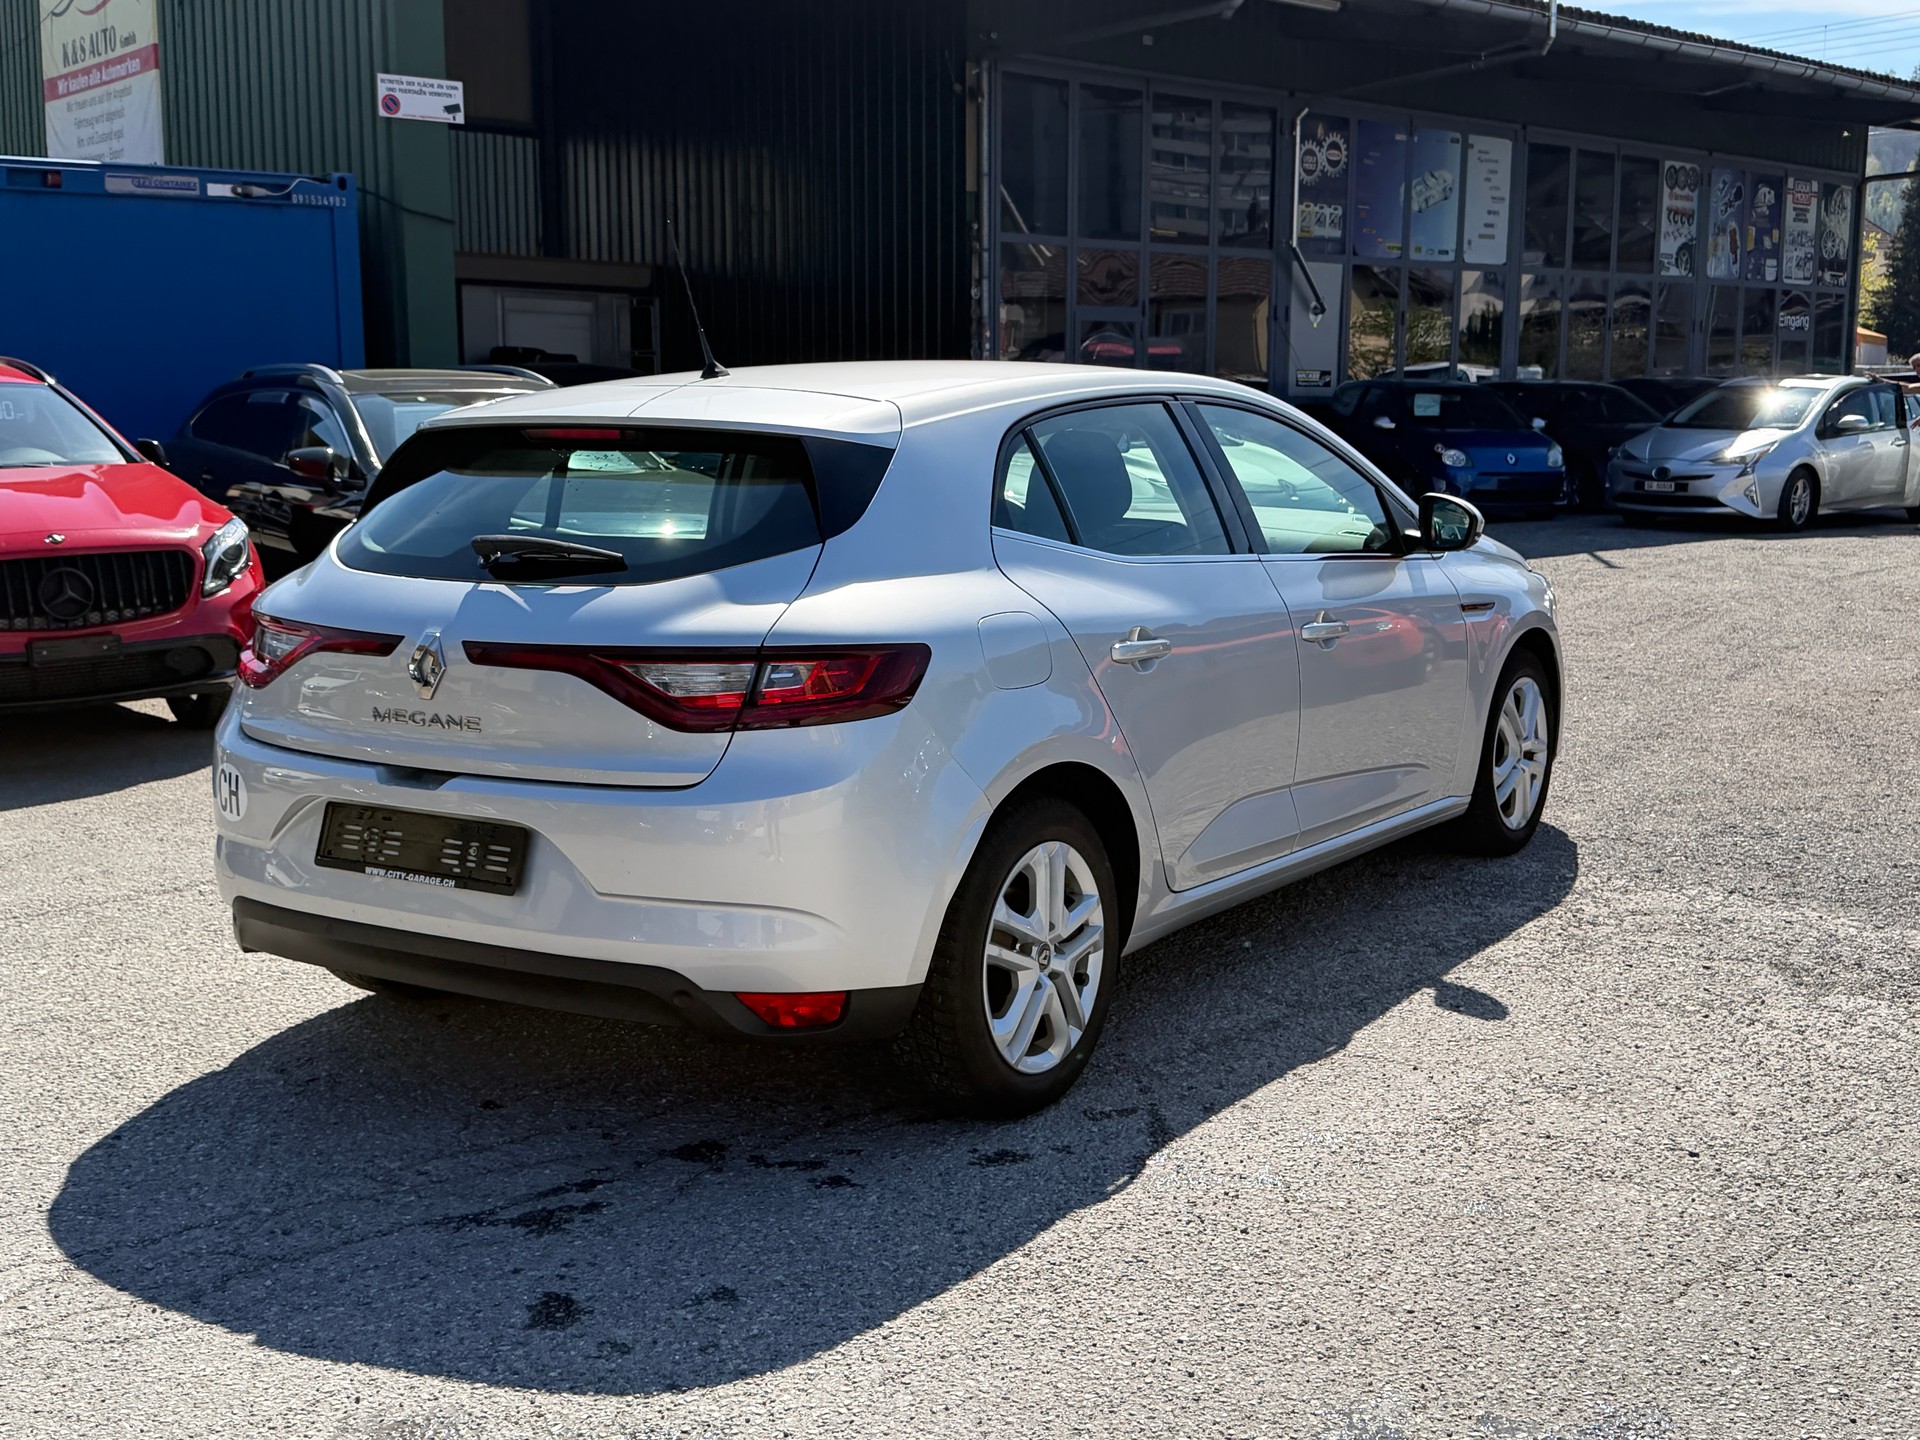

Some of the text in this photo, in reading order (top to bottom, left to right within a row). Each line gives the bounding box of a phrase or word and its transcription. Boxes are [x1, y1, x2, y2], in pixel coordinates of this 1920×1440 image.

[62, 34, 87, 68] K&S
[88, 26, 117, 59] AUTO
[57, 57, 141, 96] Wir kaufen alle Automarken
[380, 78, 404, 86] BETRETEN
[406, 79, 416, 87] DER
[428, 91, 453, 99] VERBOTEN
[153, 179, 197, 191] CONTAINEX
[1778, 312, 1810, 332] Eingang
[371, 706, 482, 733] MEGANE
[219, 766, 241, 818] CH
[365, 866, 456, 888] WWW.CITY-GARAGE.CH
